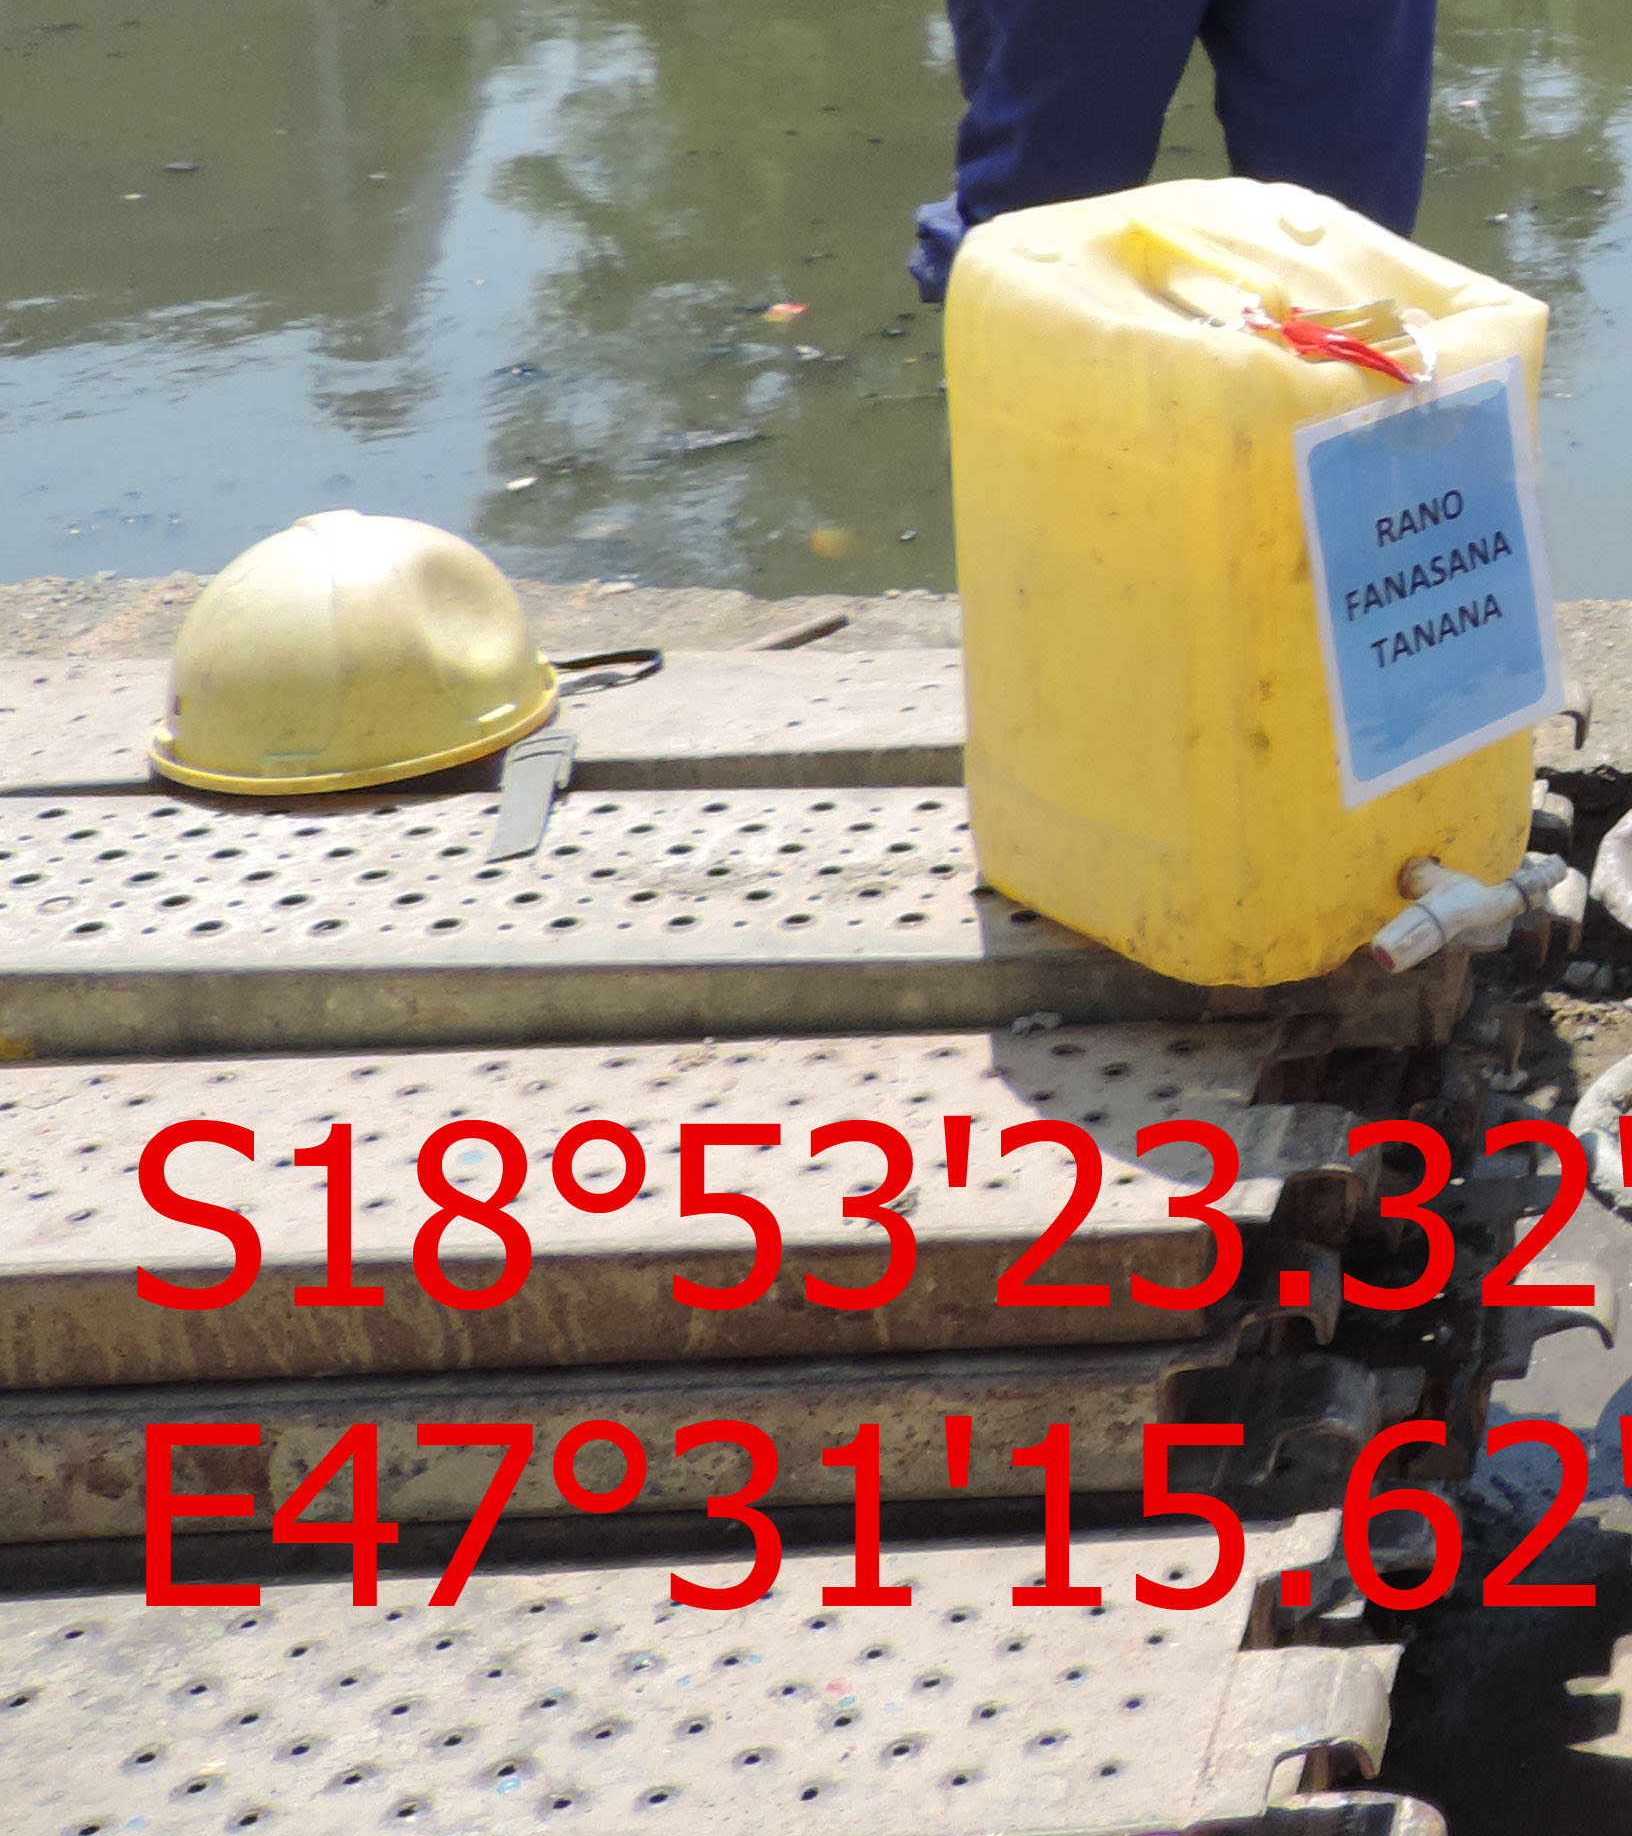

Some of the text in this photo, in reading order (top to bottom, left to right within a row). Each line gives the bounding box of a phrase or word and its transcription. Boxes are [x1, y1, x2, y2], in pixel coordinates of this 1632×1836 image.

[1375, 489, 1464, 549] RANO
[1345, 530, 1512, 622] FANASANA
[1370, 594, 1503, 669] TANANA
